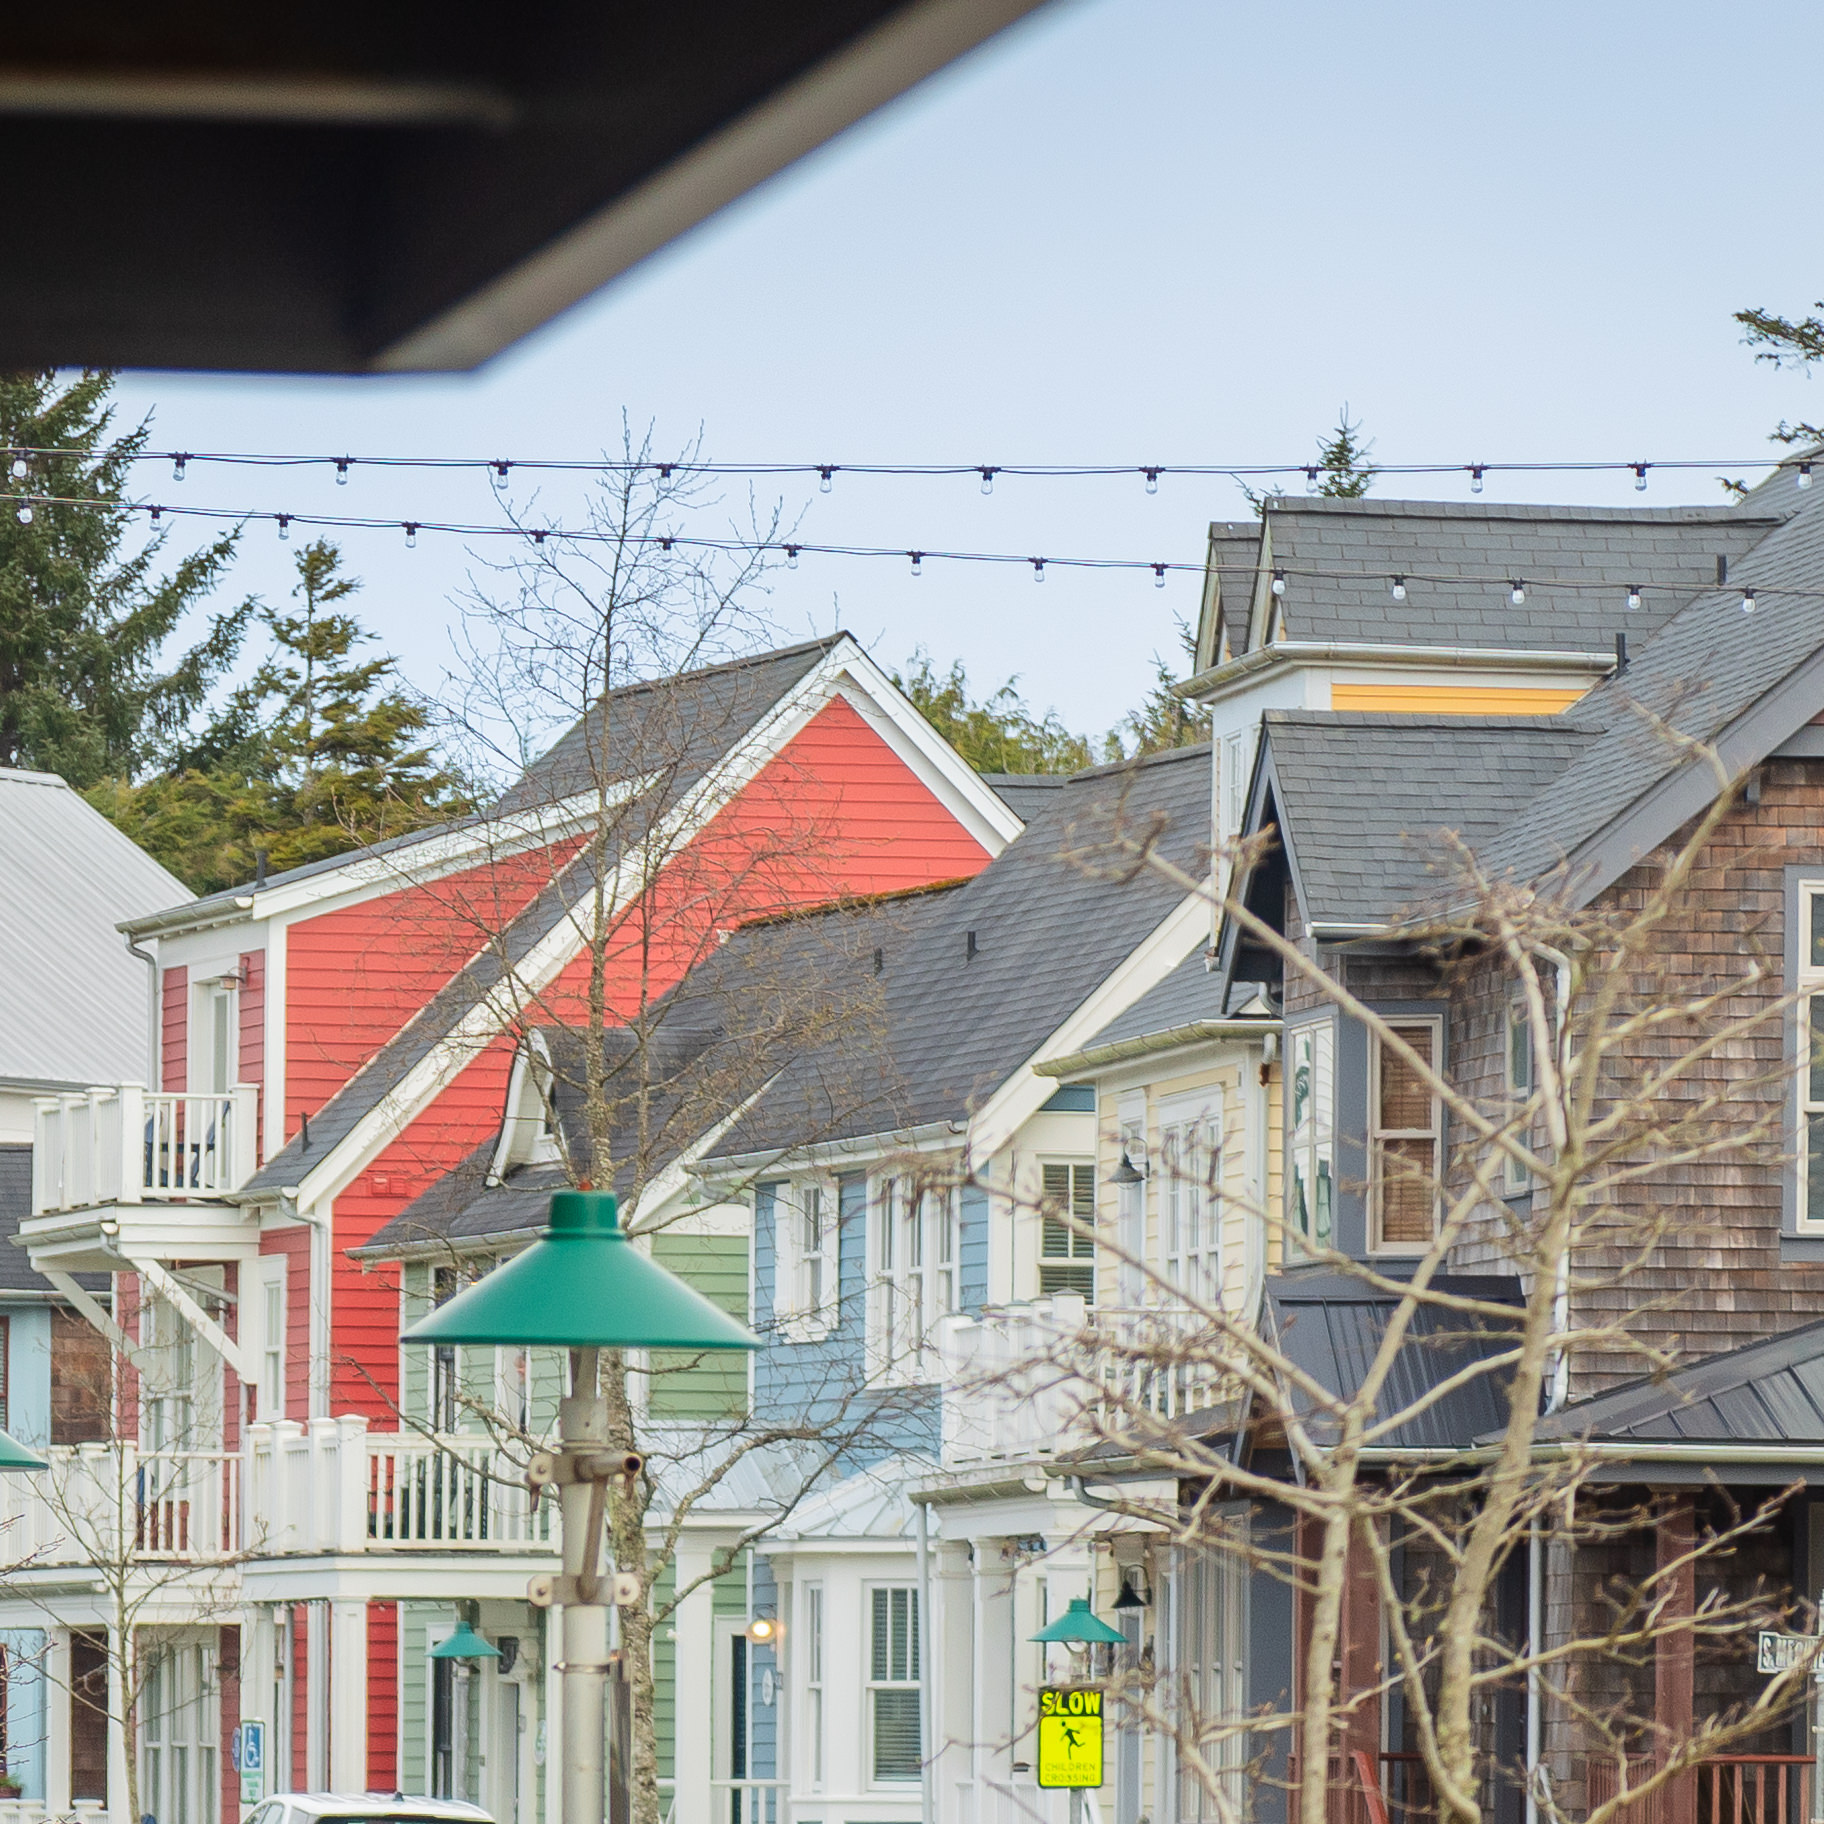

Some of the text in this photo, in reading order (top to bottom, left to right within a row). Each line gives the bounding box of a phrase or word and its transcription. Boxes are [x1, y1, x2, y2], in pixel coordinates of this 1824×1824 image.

[1041, 1690, 1101, 1715] SLOW
[1044, 1762, 1096, 1772] CHILDREN
[1044, 1773, 1096, 1783] CROSSING
